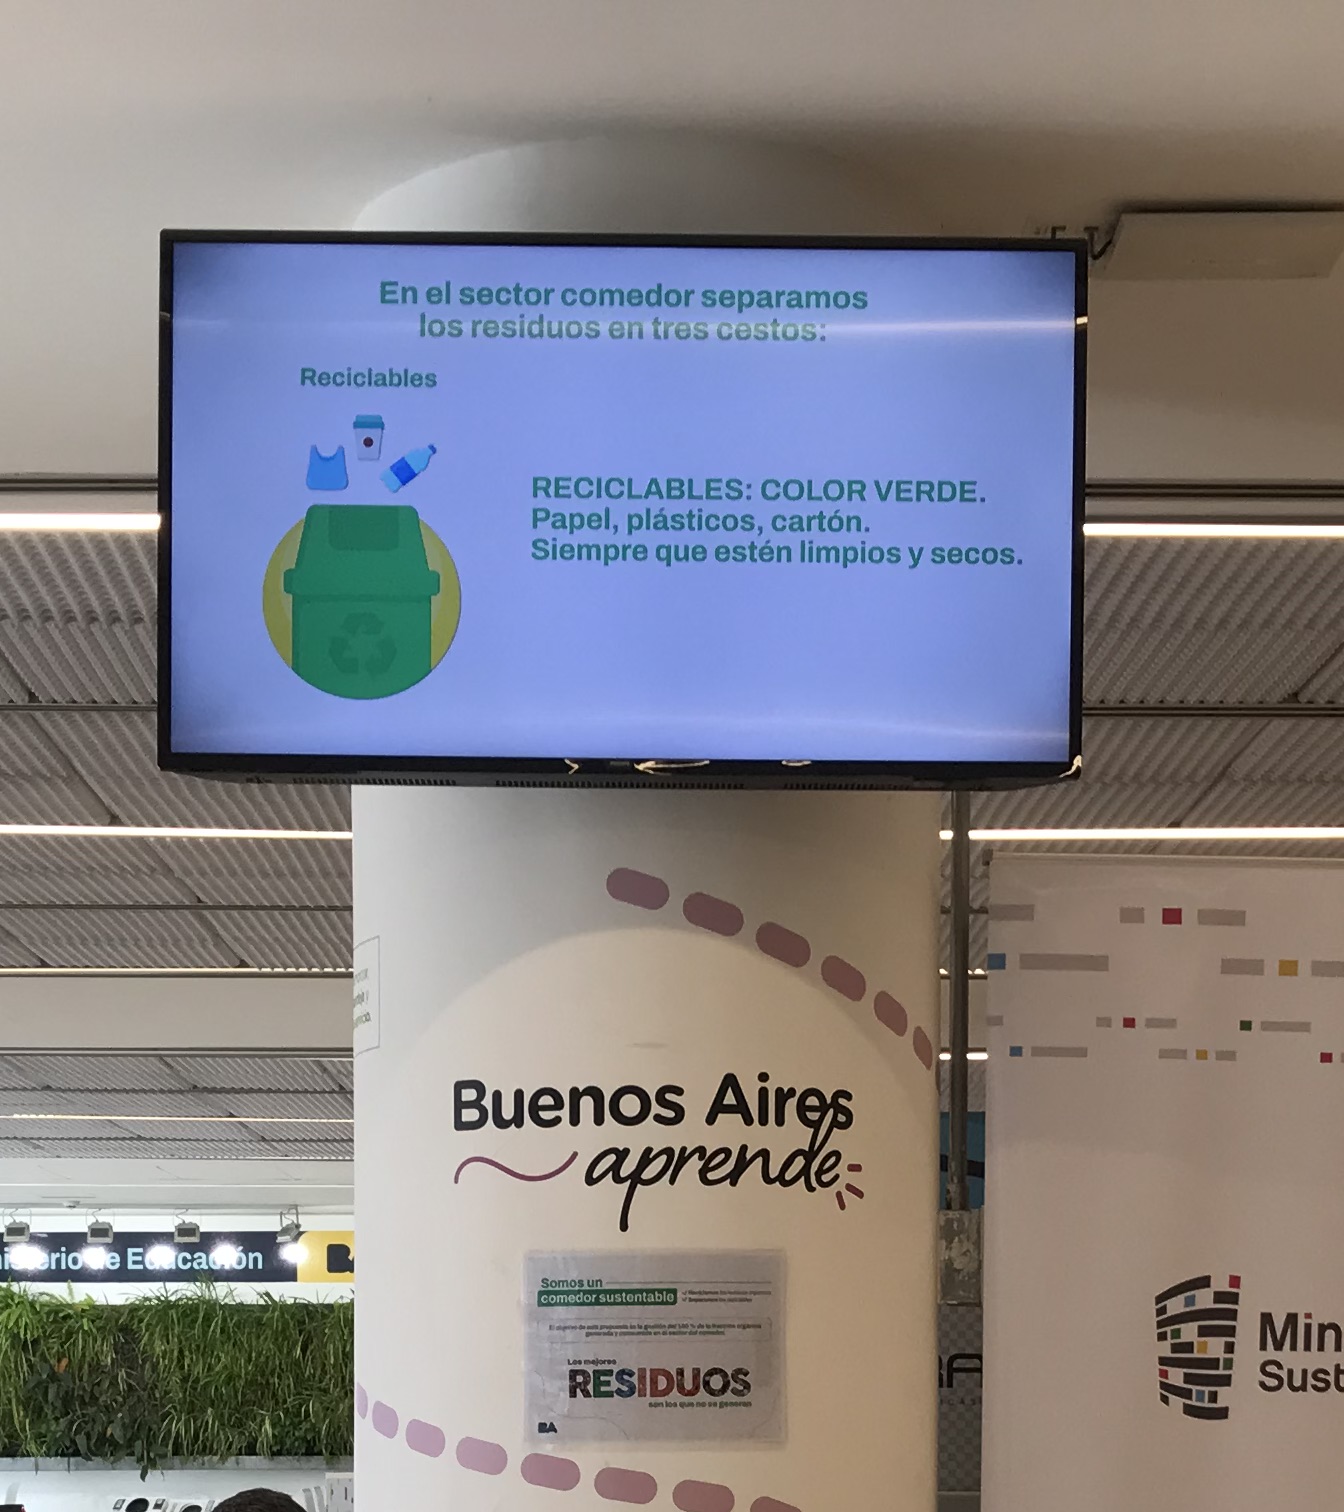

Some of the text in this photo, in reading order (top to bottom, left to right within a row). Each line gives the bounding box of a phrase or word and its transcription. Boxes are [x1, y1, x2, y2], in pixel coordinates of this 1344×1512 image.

[379, 280, 868, 313] En el sector comedor separamos
[419, 312, 826, 342] los residuos en tres cestos:
[300, 367, 438, 388] Reciclables
[532, 476, 986, 503] RECICLABLES: COLOR VERDE.
[532, 506, 870, 537] Papel, plásticos, cartón.
[531, 537, 1023, 570] Siempre que estén limpios y secos.
[453, 1072, 856, 1132] Buenos Aires
[585, 1100, 842, 1232] aprende
[127, 1246, 263, 1270] Ecacón
[540, 1277, 603, 1289] Somos un
[540, 1291, 598, 1304] comedor
[599, 1290, 675, 1303] sustentable
[567, 1358, 617, 1367] Los mejores
[568, 1367, 752, 1399] RESIDUOS
